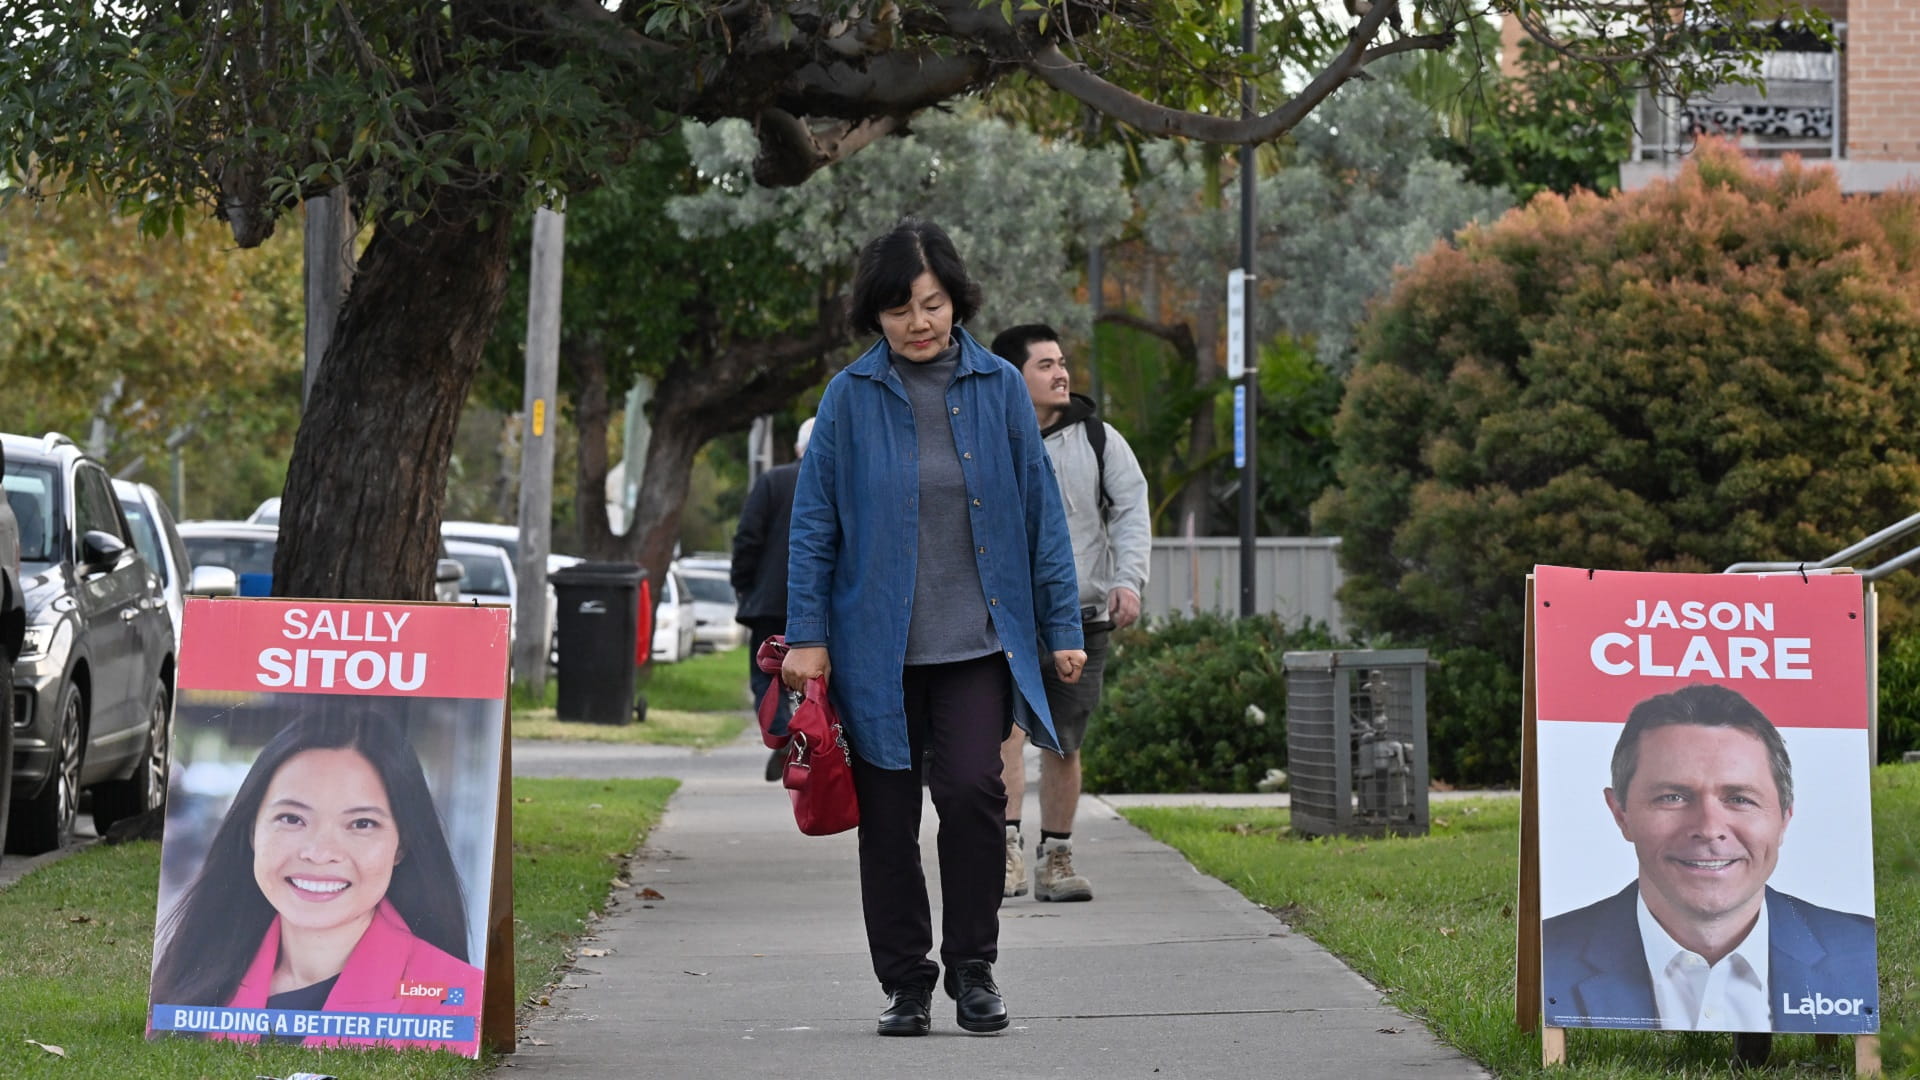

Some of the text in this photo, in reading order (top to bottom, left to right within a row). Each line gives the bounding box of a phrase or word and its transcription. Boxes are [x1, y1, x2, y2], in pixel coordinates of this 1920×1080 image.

[282, 609, 410, 642] SALLY
[1625, 600, 1775, 631] JASON
[256, 648, 427, 691] SITOU
[1590, 633, 1813, 680] CLARE
[400, 983, 443, 997] Labor
[1783, 993, 1864, 1016] Labor
[174, 1010, 454, 1038] BUILDING A BETTER FUTURE
